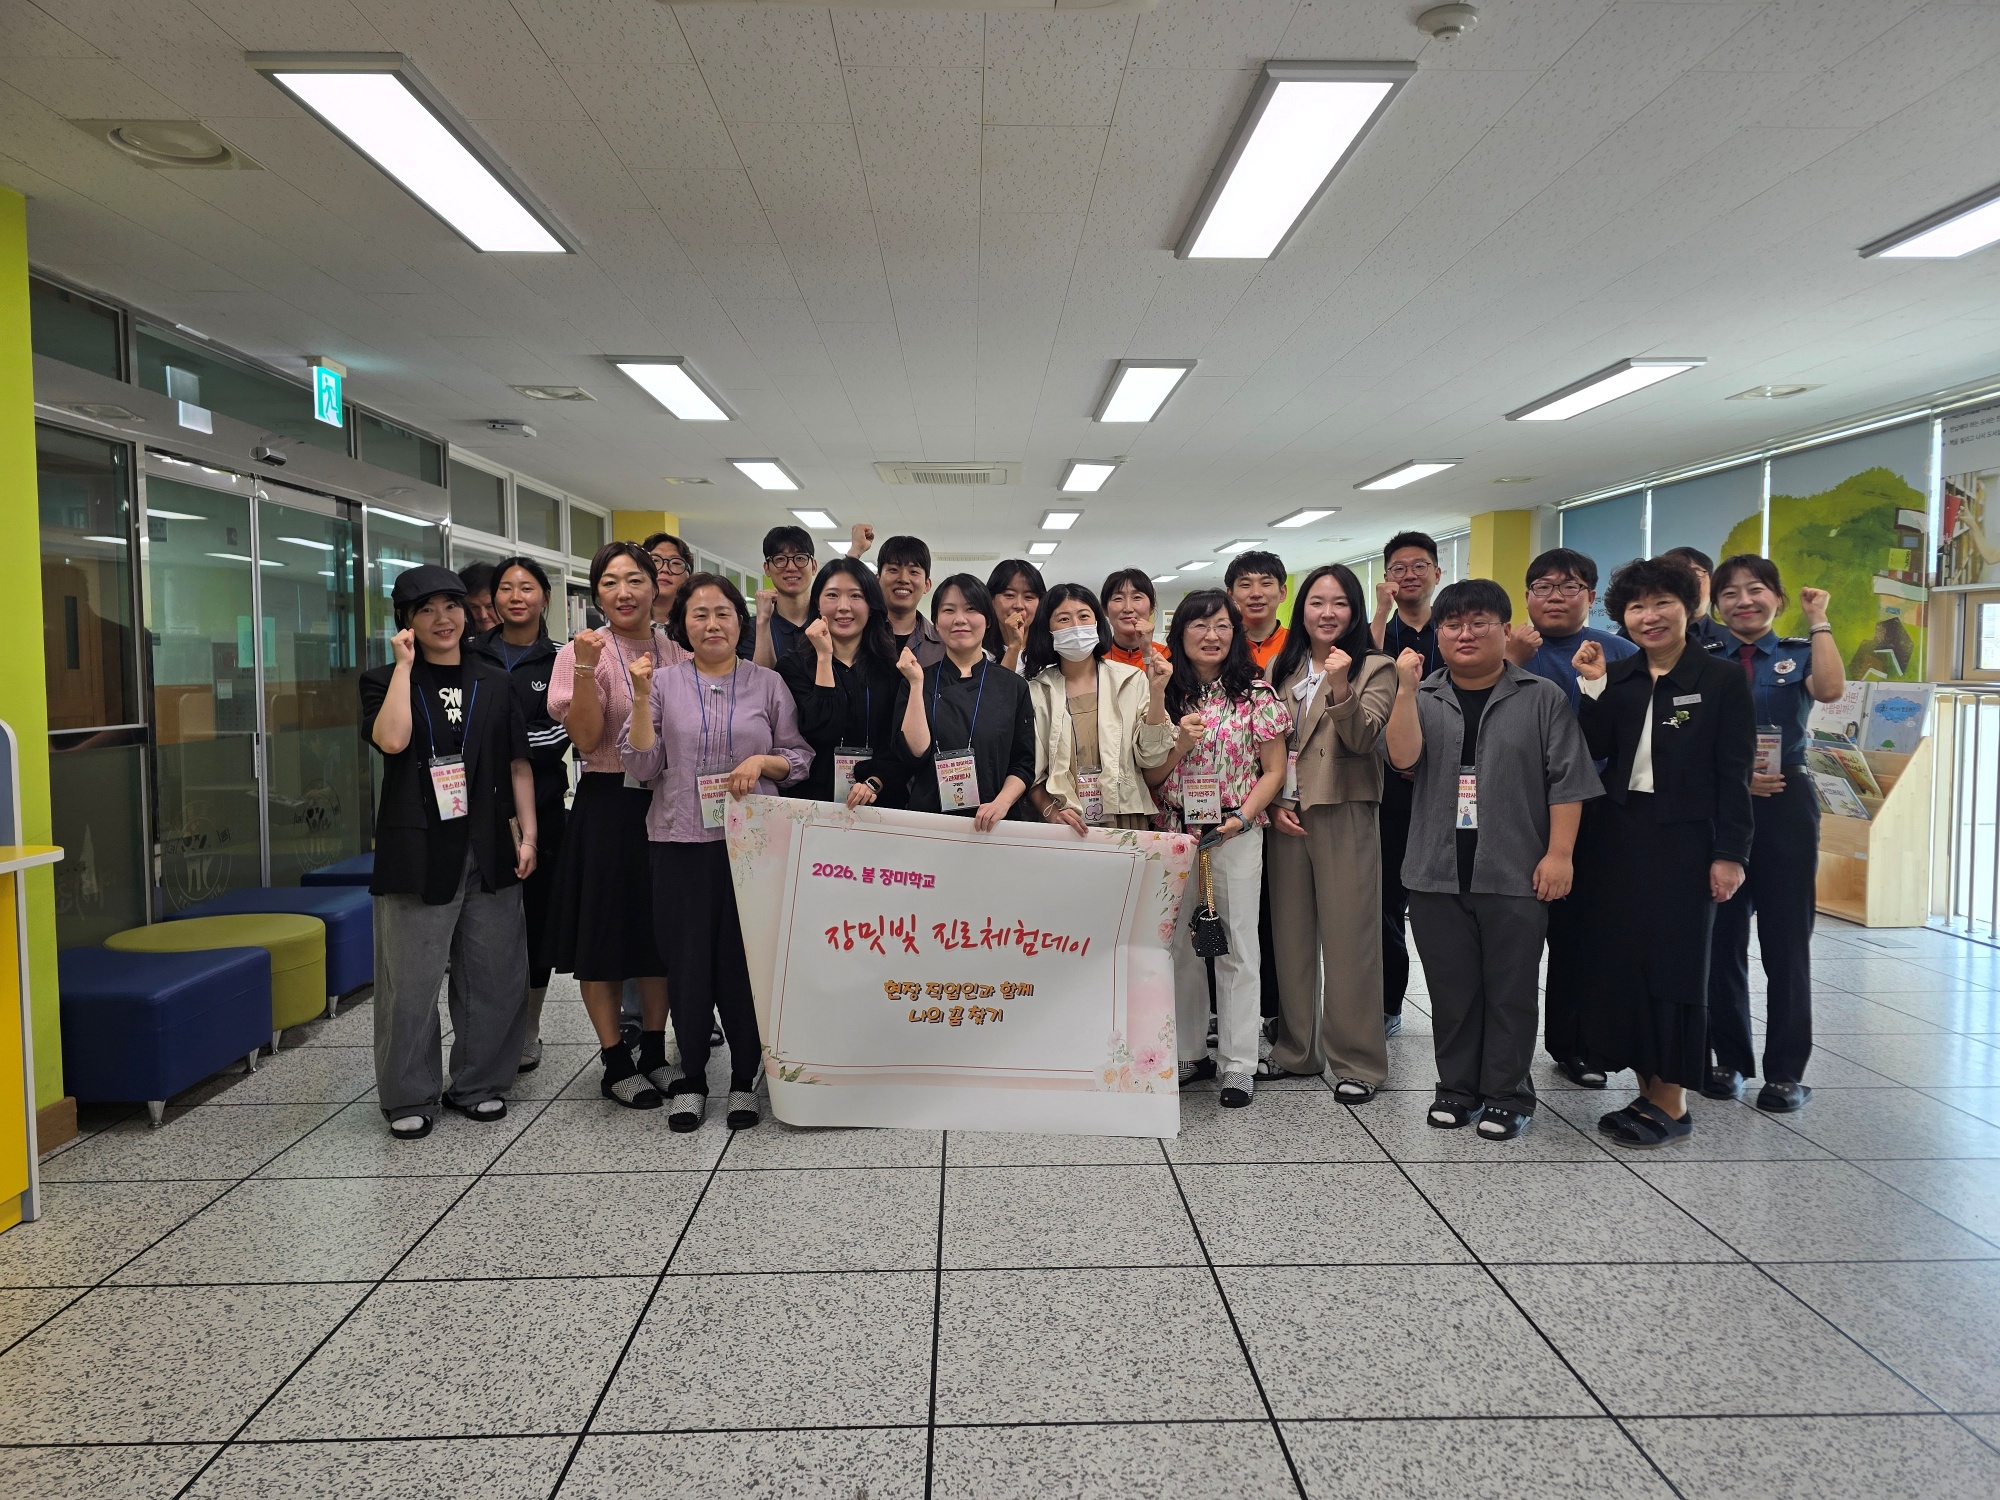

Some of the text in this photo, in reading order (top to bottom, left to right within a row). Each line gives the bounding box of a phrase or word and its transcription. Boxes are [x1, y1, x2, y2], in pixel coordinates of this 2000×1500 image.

[1821, 703, 1855, 715] 사람일까?
[1080, 789, 1102, 798] 임상심리
[812, 861, 937, 890] 2026. 봄 장미학교
[824, 914, 1091, 957] 장밋빛 진로체험데이
[883, 979, 1034, 1001] 현장 직업인과 함께
[908, 1005, 1004, 1027] 나의 꿈 찾기
